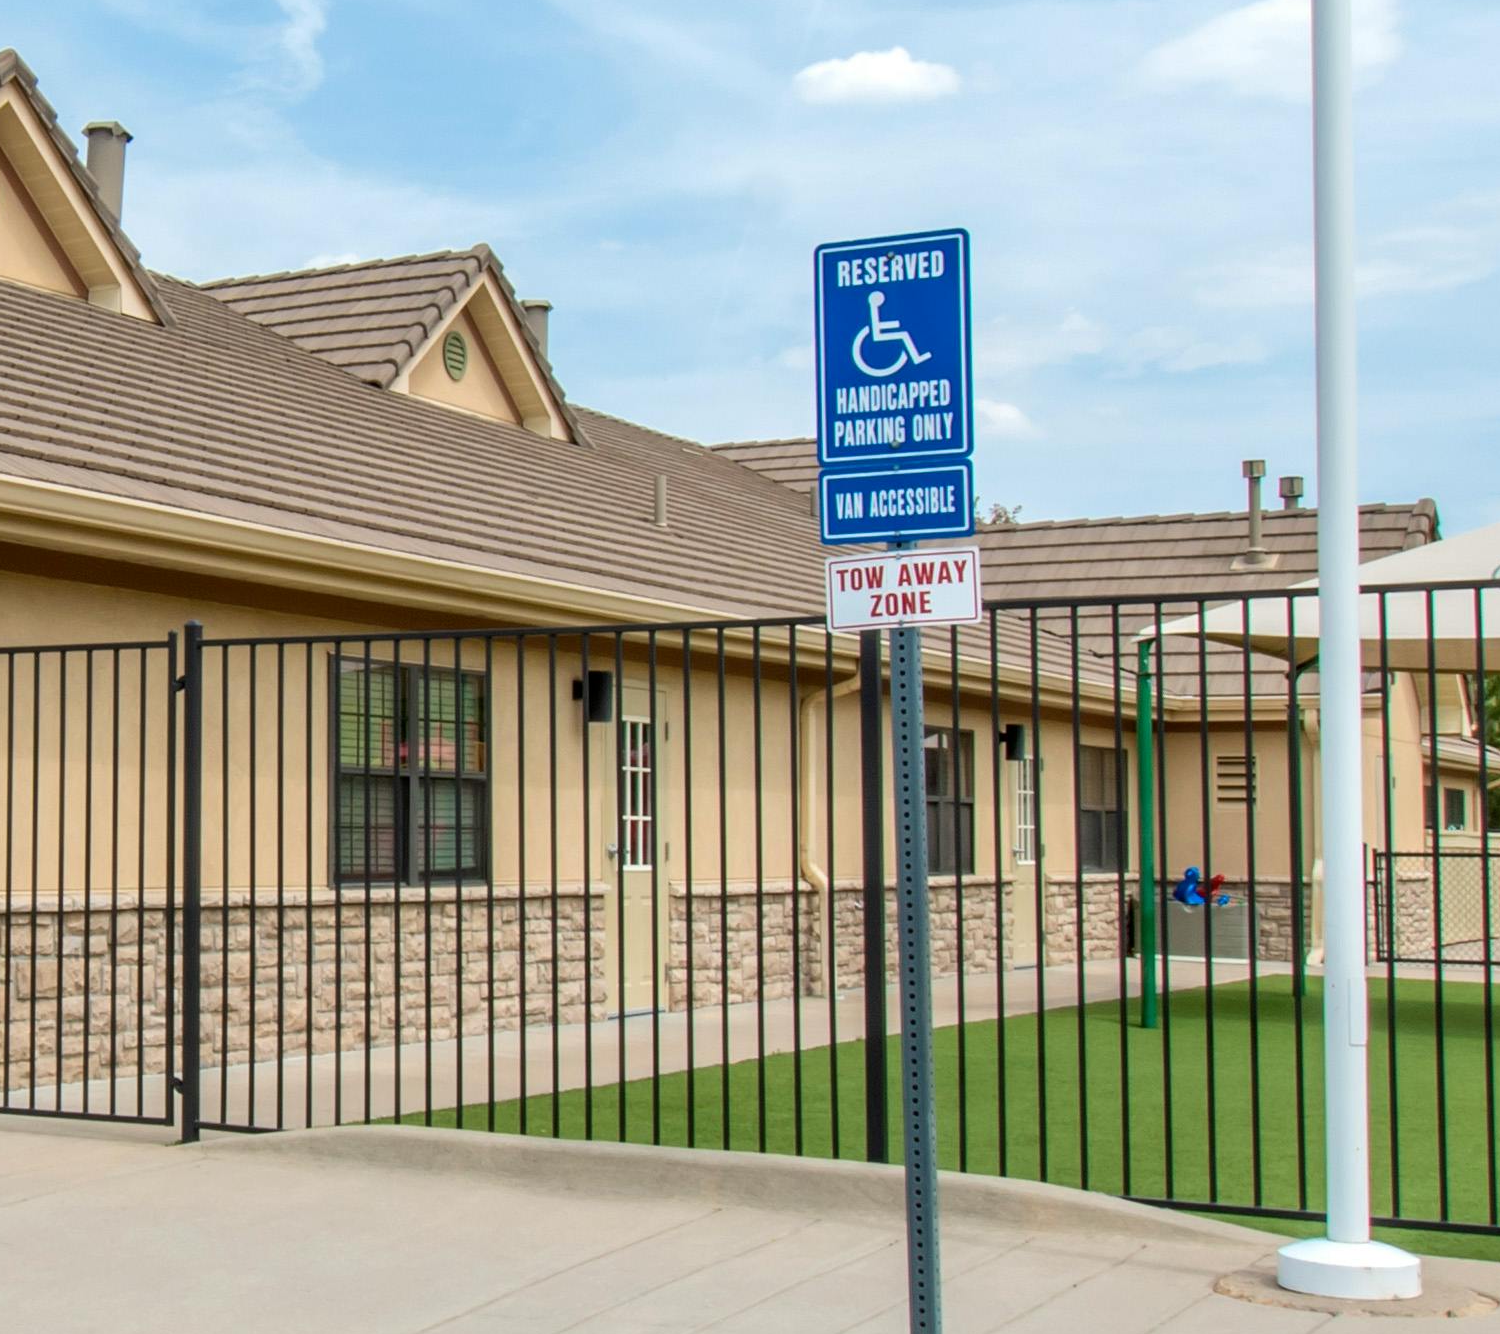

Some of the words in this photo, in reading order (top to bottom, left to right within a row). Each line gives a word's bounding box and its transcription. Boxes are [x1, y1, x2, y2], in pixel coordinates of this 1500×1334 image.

[837, 250, 944, 287] RESERVED
[836, 379, 951, 415] HANDICAPPED
[834, 417, 906, 447] PARKING
[913, 412, 954, 442] ONLY
[835, 492, 863, 520] VAN
[870, 485, 956, 517] ACCESSIBLE
[836, 565, 885, 592] TOW
[897, 559, 967, 587] AWAY
[870, 591, 933, 617] ZONE
